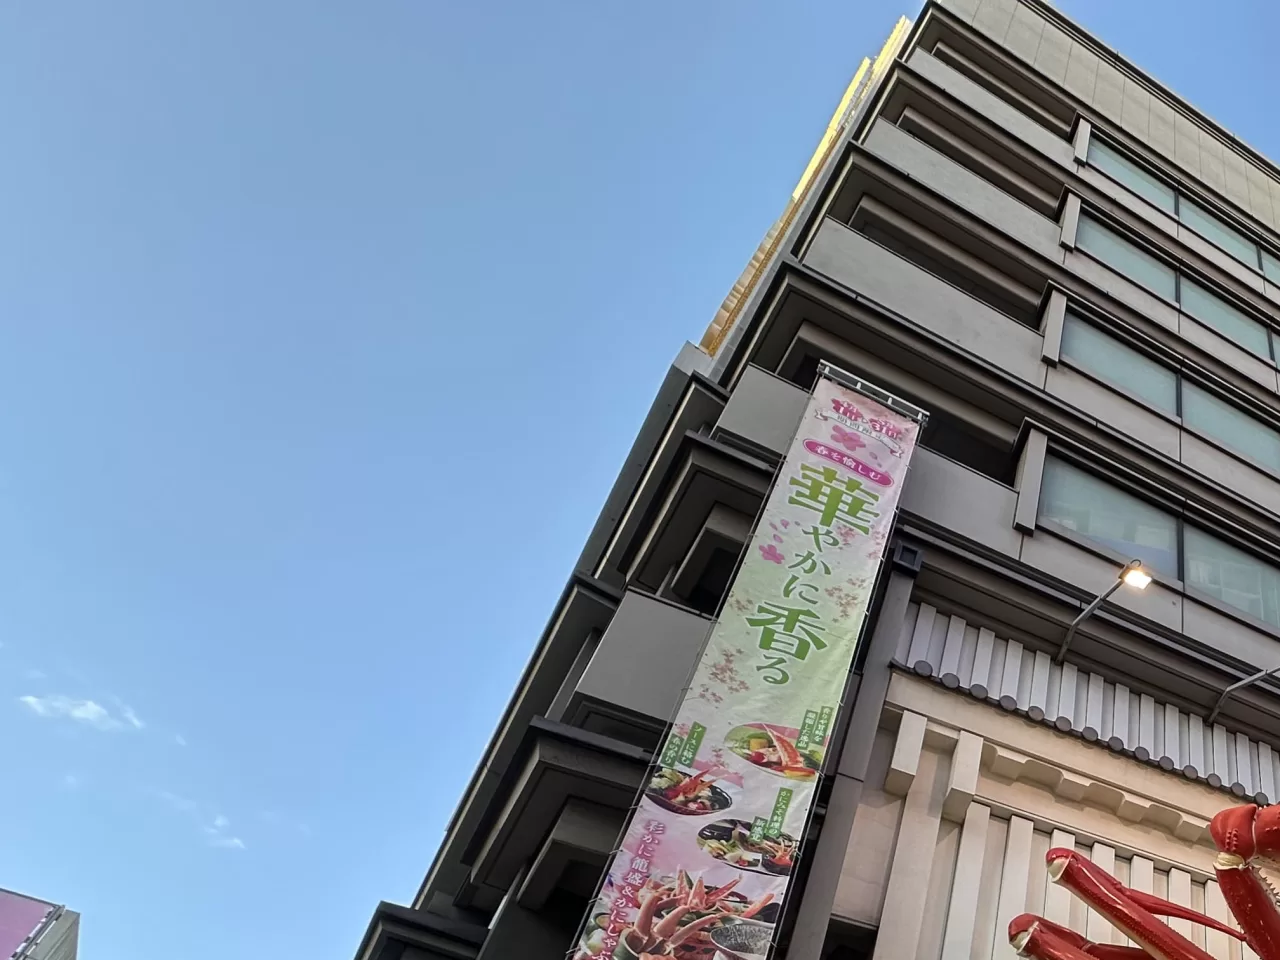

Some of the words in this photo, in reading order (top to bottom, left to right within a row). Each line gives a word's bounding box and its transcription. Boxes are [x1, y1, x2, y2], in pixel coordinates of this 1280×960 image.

[746, 463, 880, 685] 華やかに香る
